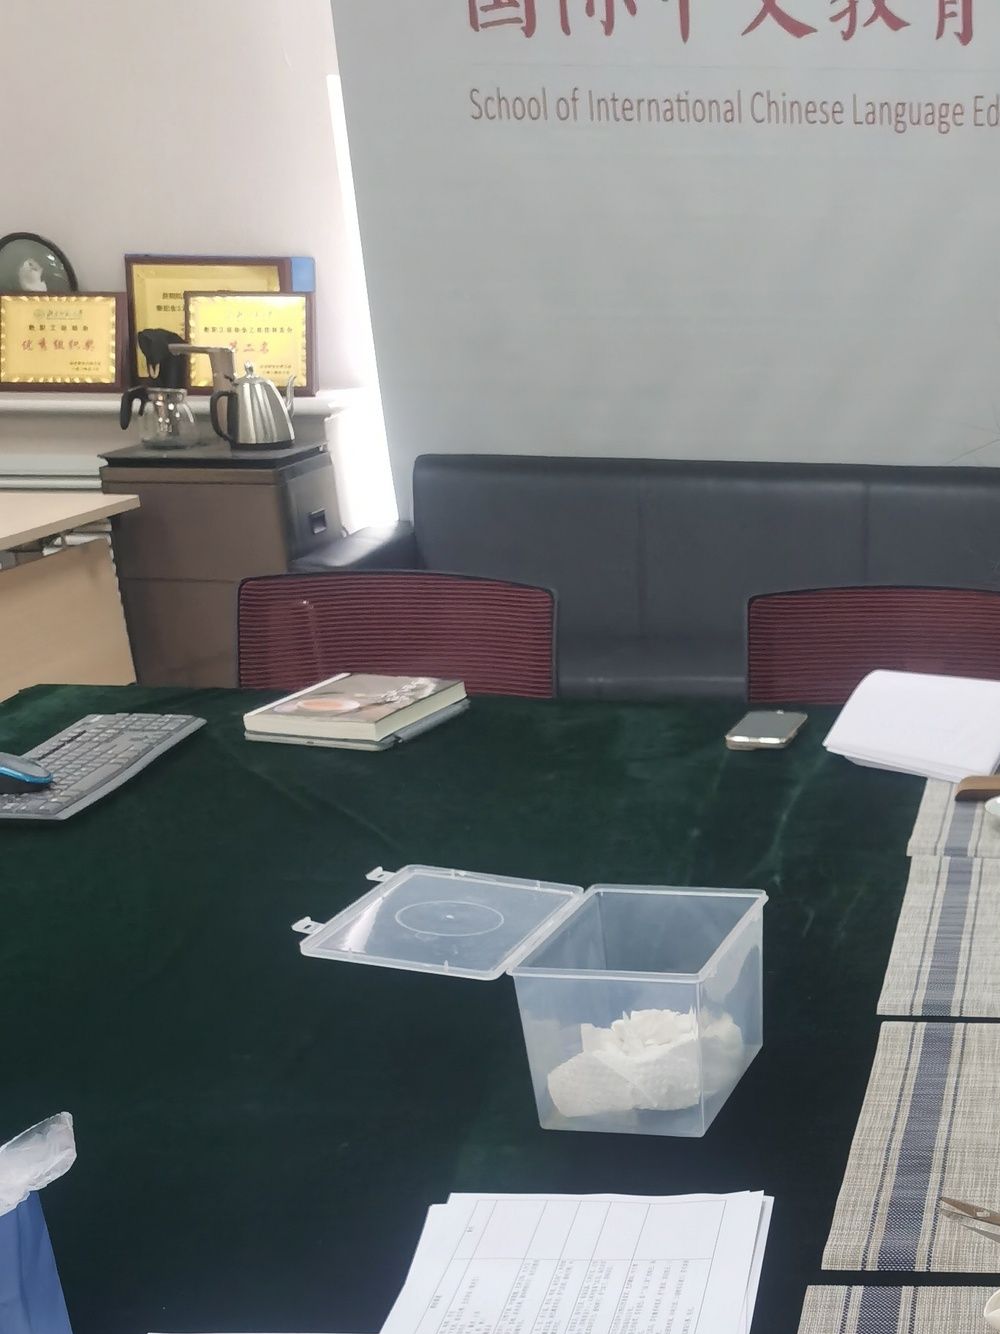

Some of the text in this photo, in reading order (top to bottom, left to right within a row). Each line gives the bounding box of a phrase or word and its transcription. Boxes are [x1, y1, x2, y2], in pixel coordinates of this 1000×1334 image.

[470, 87, 546, 121] School
[556, 87, 580, 121] of
[588, 89, 742, 124] International
[751, 91, 843, 125] Chinese
[852, 93, 965, 134] Language
